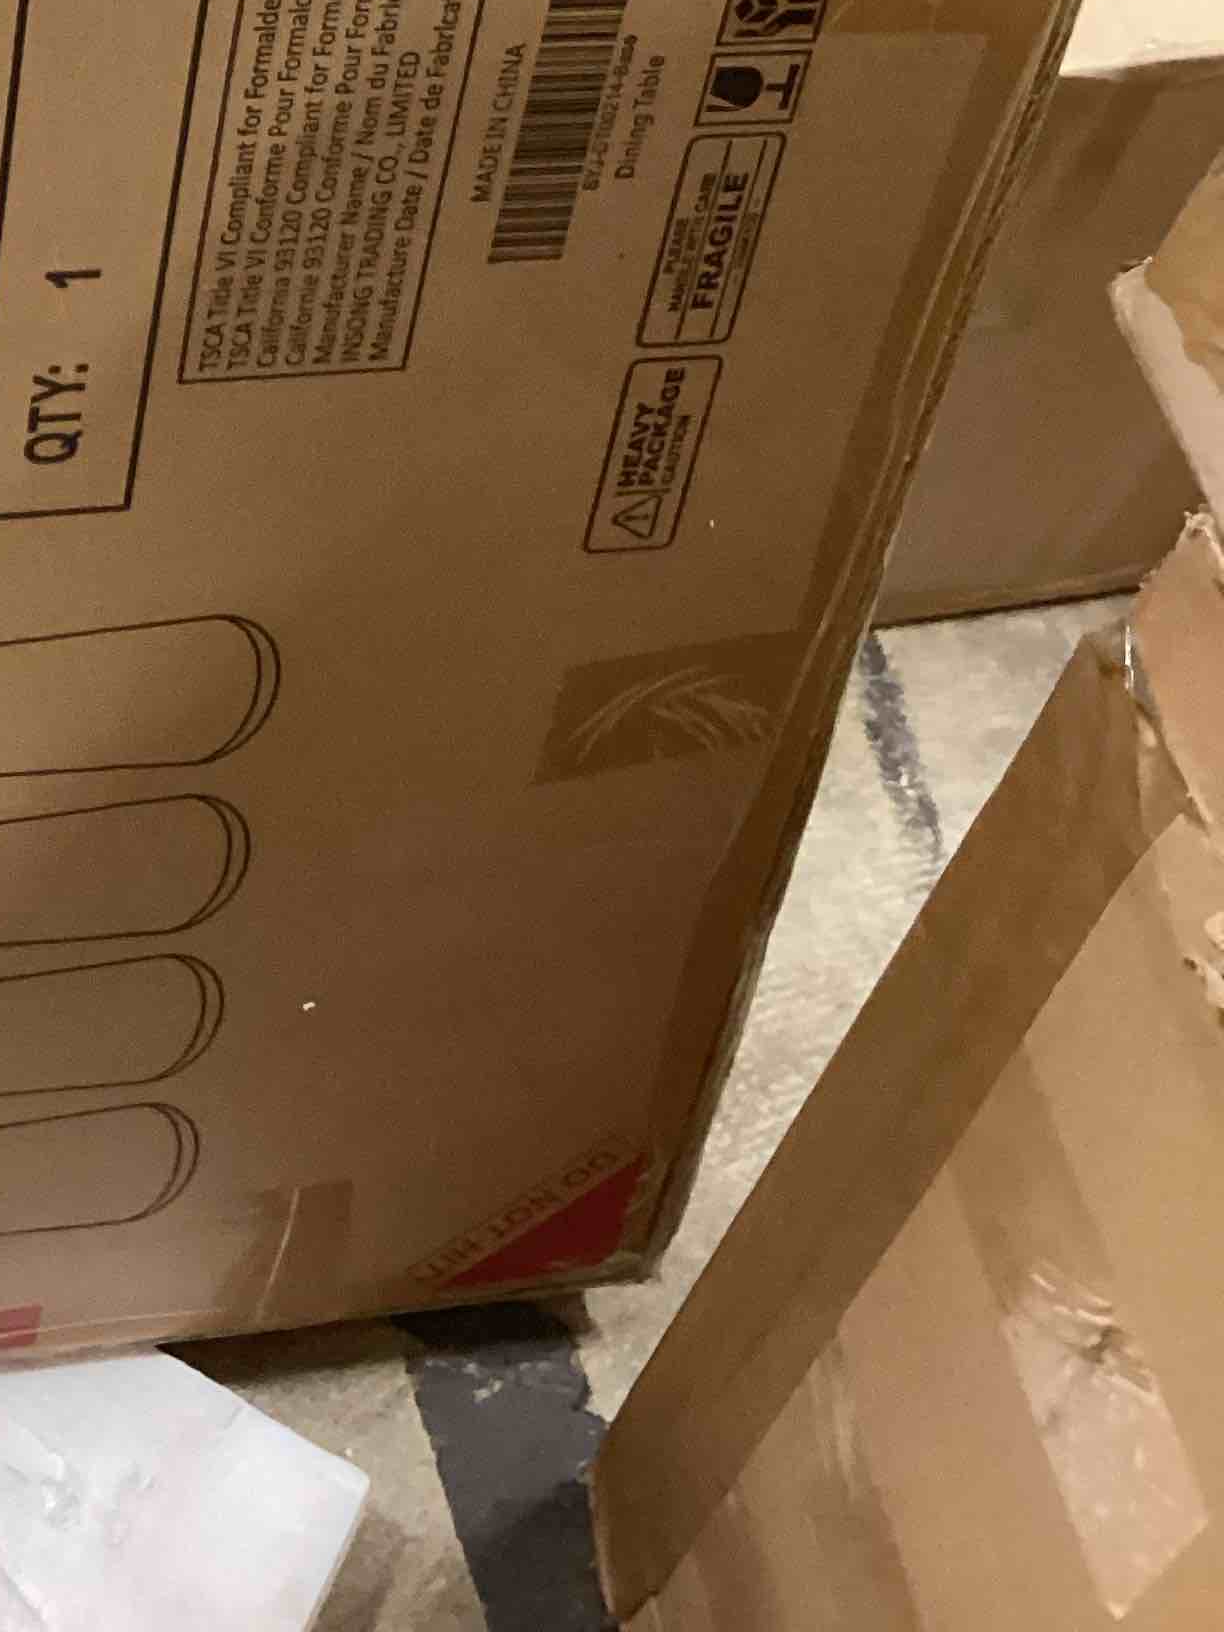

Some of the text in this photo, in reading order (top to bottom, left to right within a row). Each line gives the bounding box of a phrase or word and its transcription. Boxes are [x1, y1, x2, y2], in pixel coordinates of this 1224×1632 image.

[305, 63, 329, 92] for
[336, 45, 362, 94] Pour
[366, 63, 388, 89] du
[420, 83, 442, 109] de
[238, 105, 262, 135] for
[287, 99, 324, 204] Compliant
[316, 101, 350, 201] Conforme
[355, 96, 382, 145] Nom
[409, 116, 436, 163] Date
[469, 44, 527, 202] MADE IN CHINA
[612, 55, 667, 178] Dining Table
[221, 141, 257, 244] Compliant
[339, 167, 368, 224] Name
[358, 189, 391, 279] TRADING
[386, 51, 419, 136] LIMITED
[395, 184, 421, 230] Date
[228, 321, 253, 370] TSCA
[251, 143, 284, 243] Conforme
[268, 87, 295, 136] Pour
[275, 210, 301, 271] 93120
[304, 207, 330, 269] 93120
[693, 172, 747, 309] FRAGILE
[208, 276, 233, 319] Title
[258, 276, 289, 368] California
[314, 231, 354, 364] Manufacturer
[370, 236, 409, 360] Manufacture
[22, 266, 102, 466] QTY: 1
[199, 322, 225, 371] TSCA
[615, 401, 656, 487] HEAVY
[635, 367, 686, 485] PACKAGE
